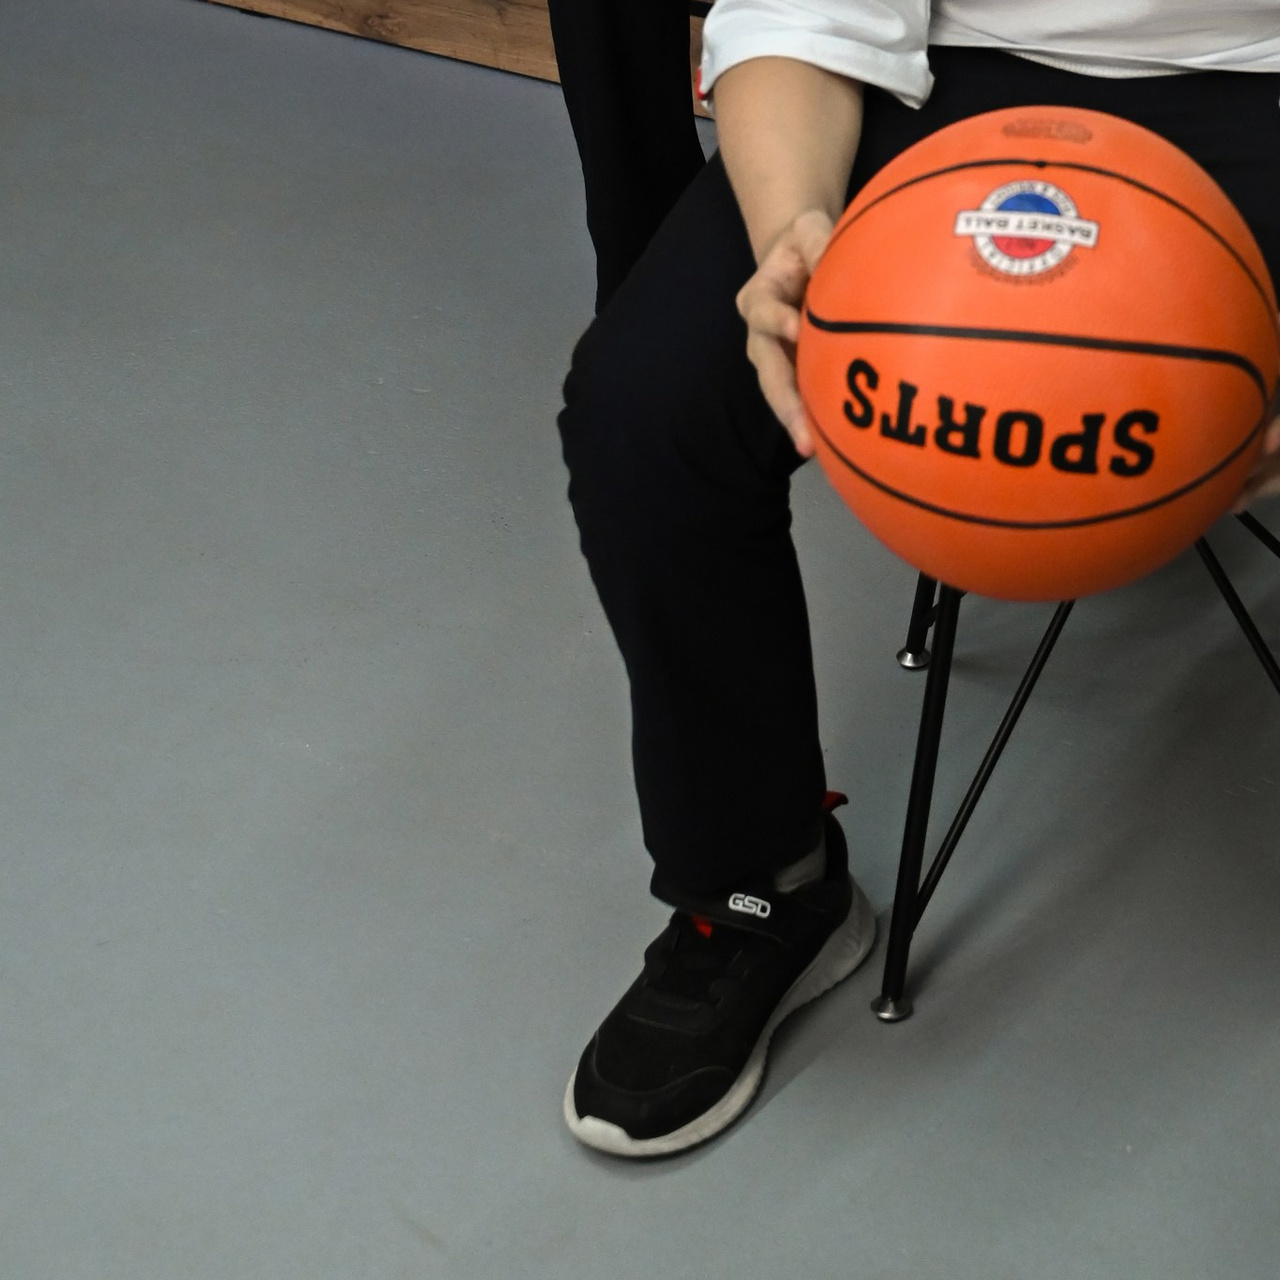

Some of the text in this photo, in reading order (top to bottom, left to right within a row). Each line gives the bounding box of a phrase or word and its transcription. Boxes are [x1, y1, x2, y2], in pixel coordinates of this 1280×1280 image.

[963, 215, 1094, 241] BASKET BALL
[843, 358, 1160, 477] SPORTS
[728, 892, 771, 919] GSD
